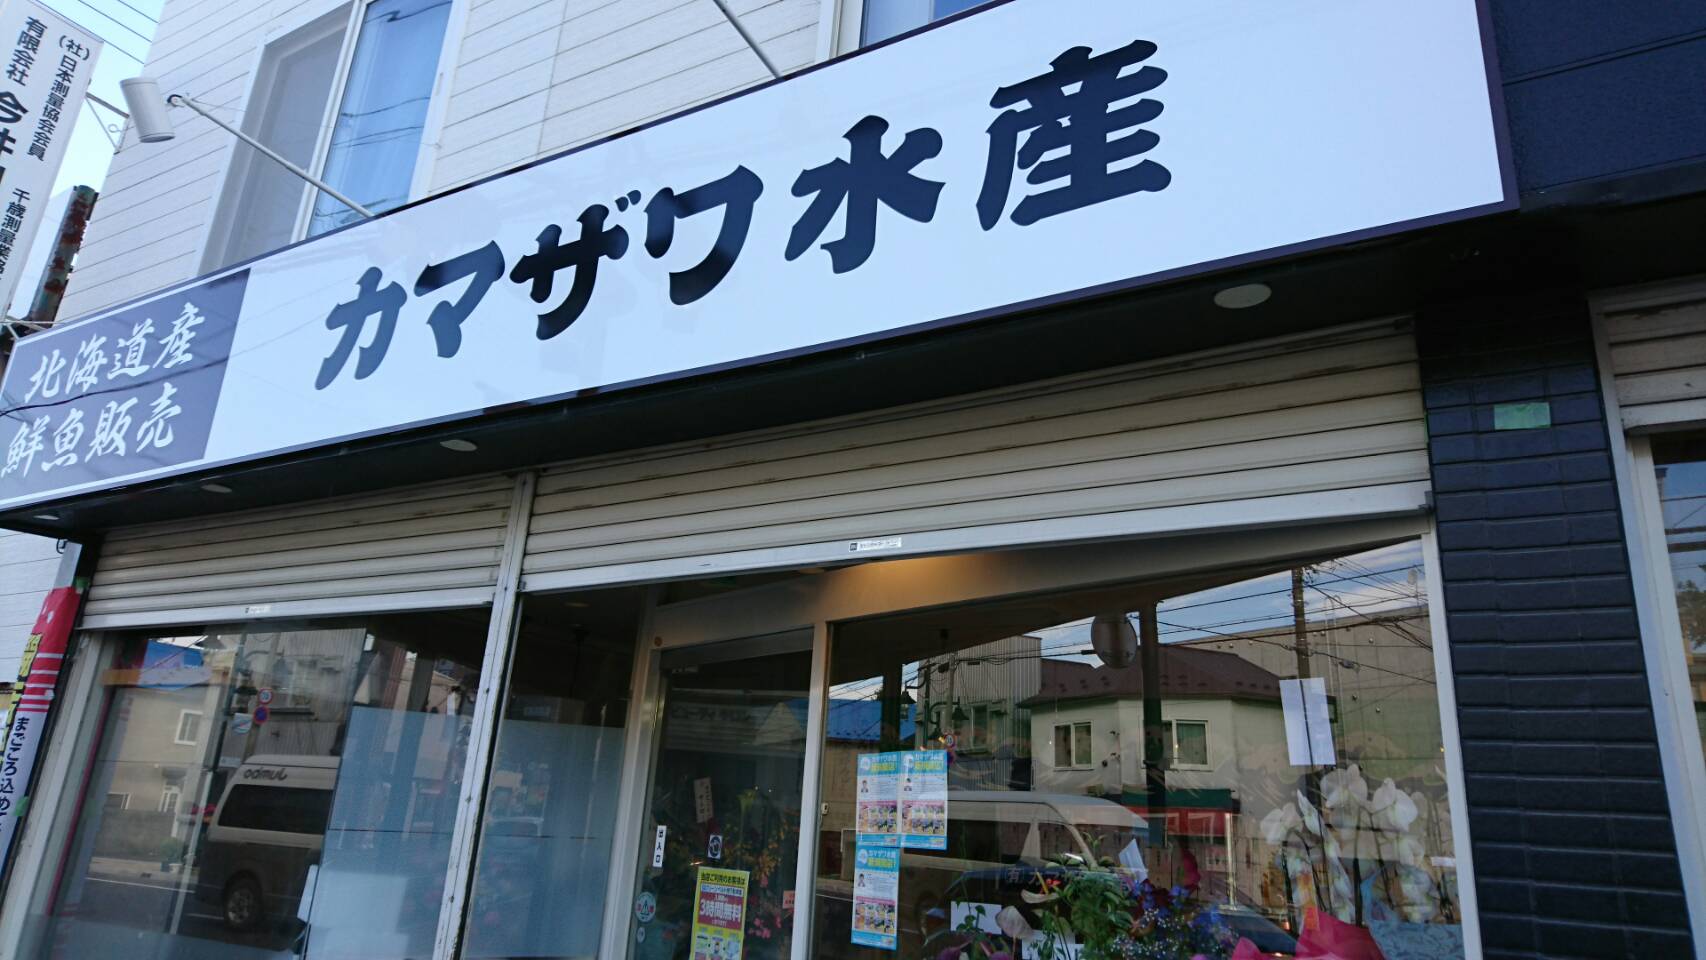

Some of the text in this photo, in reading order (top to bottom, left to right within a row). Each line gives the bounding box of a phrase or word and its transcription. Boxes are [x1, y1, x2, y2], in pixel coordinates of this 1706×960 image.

[6, 16, 48, 86] 有限会社
[315, 39, 1172, 391] カマザワ水産
[25, 302, 205, 403] 北海道産
[0, 382, 182, 478] 鮮魚販売
[699, 898, 742, 922] 3時間無料
